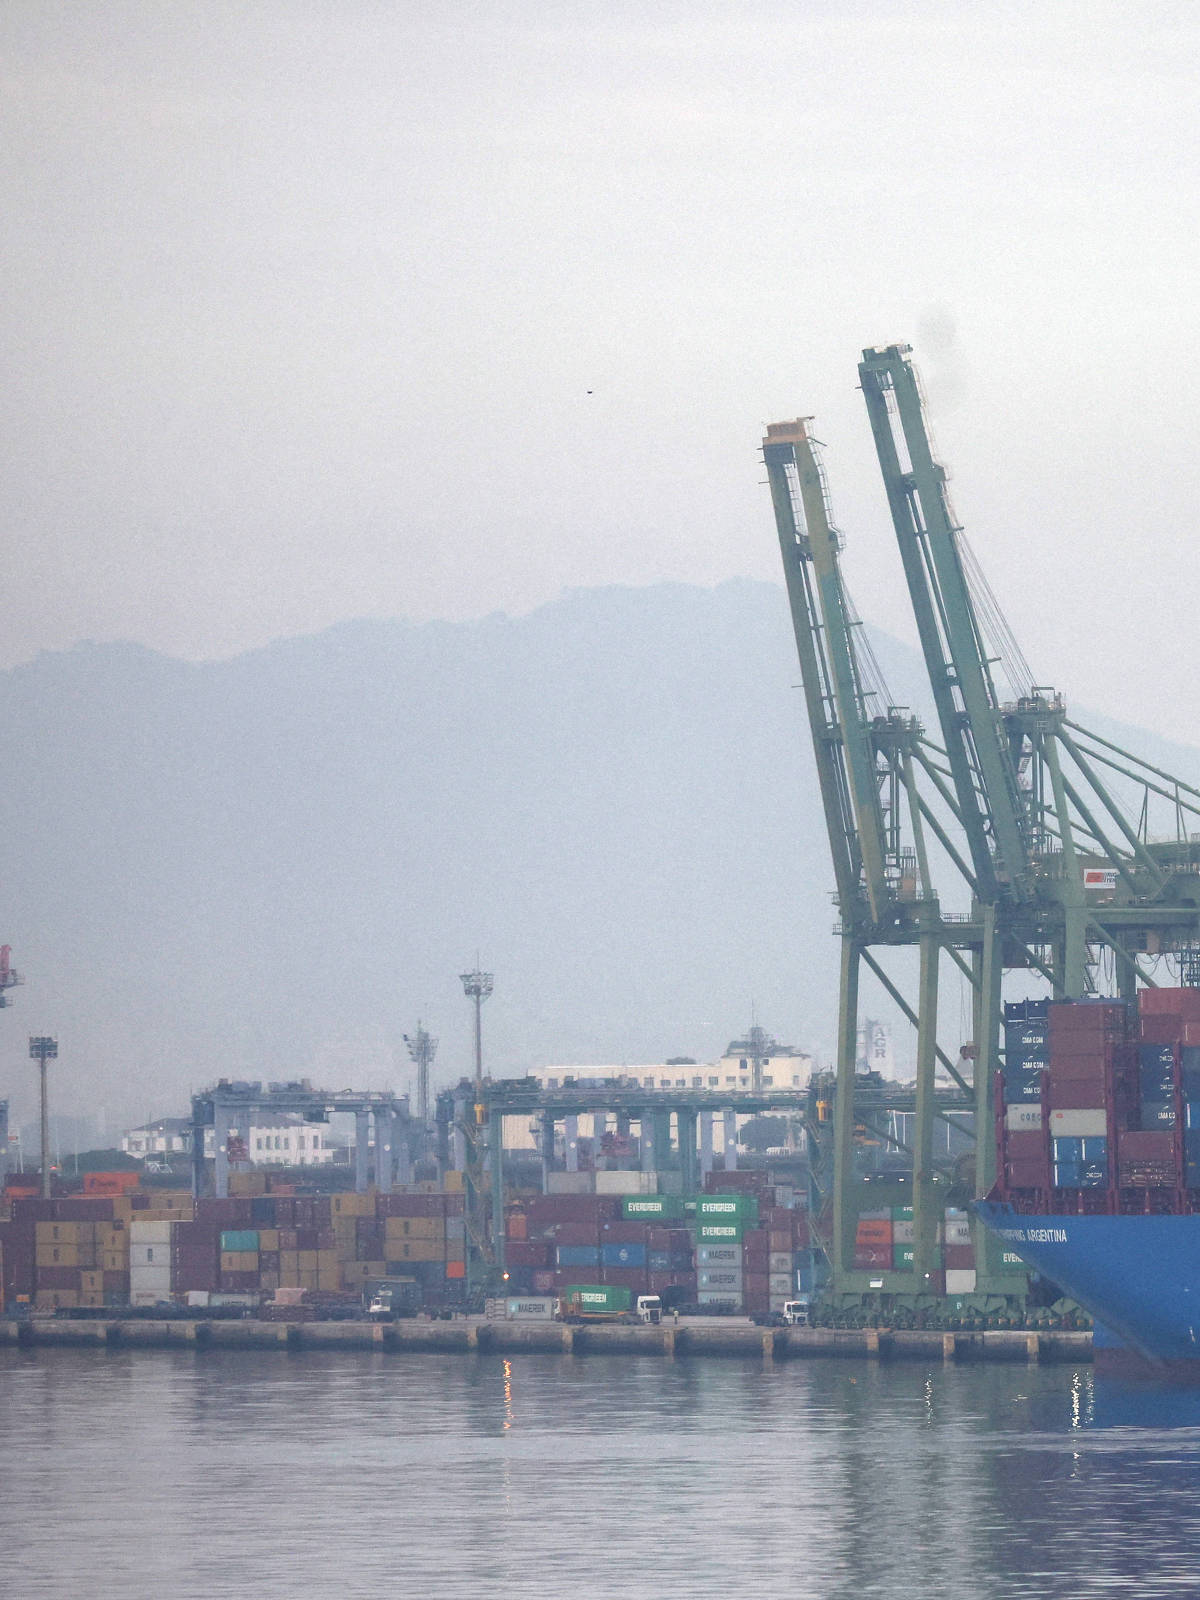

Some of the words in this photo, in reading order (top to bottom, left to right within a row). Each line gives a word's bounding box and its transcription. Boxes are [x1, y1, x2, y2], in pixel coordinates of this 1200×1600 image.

[1020, 1113, 1042, 1121] COSC
[628, 1202, 662, 1211] EVERGREEN
[702, 1203, 736, 1212] EVERGREEN
[702, 1226, 736, 1236] EVERGREEN
[1027, 1228, 1068, 1242] ARGENTINA
[580, 1292, 606, 1303] ERGREEN
